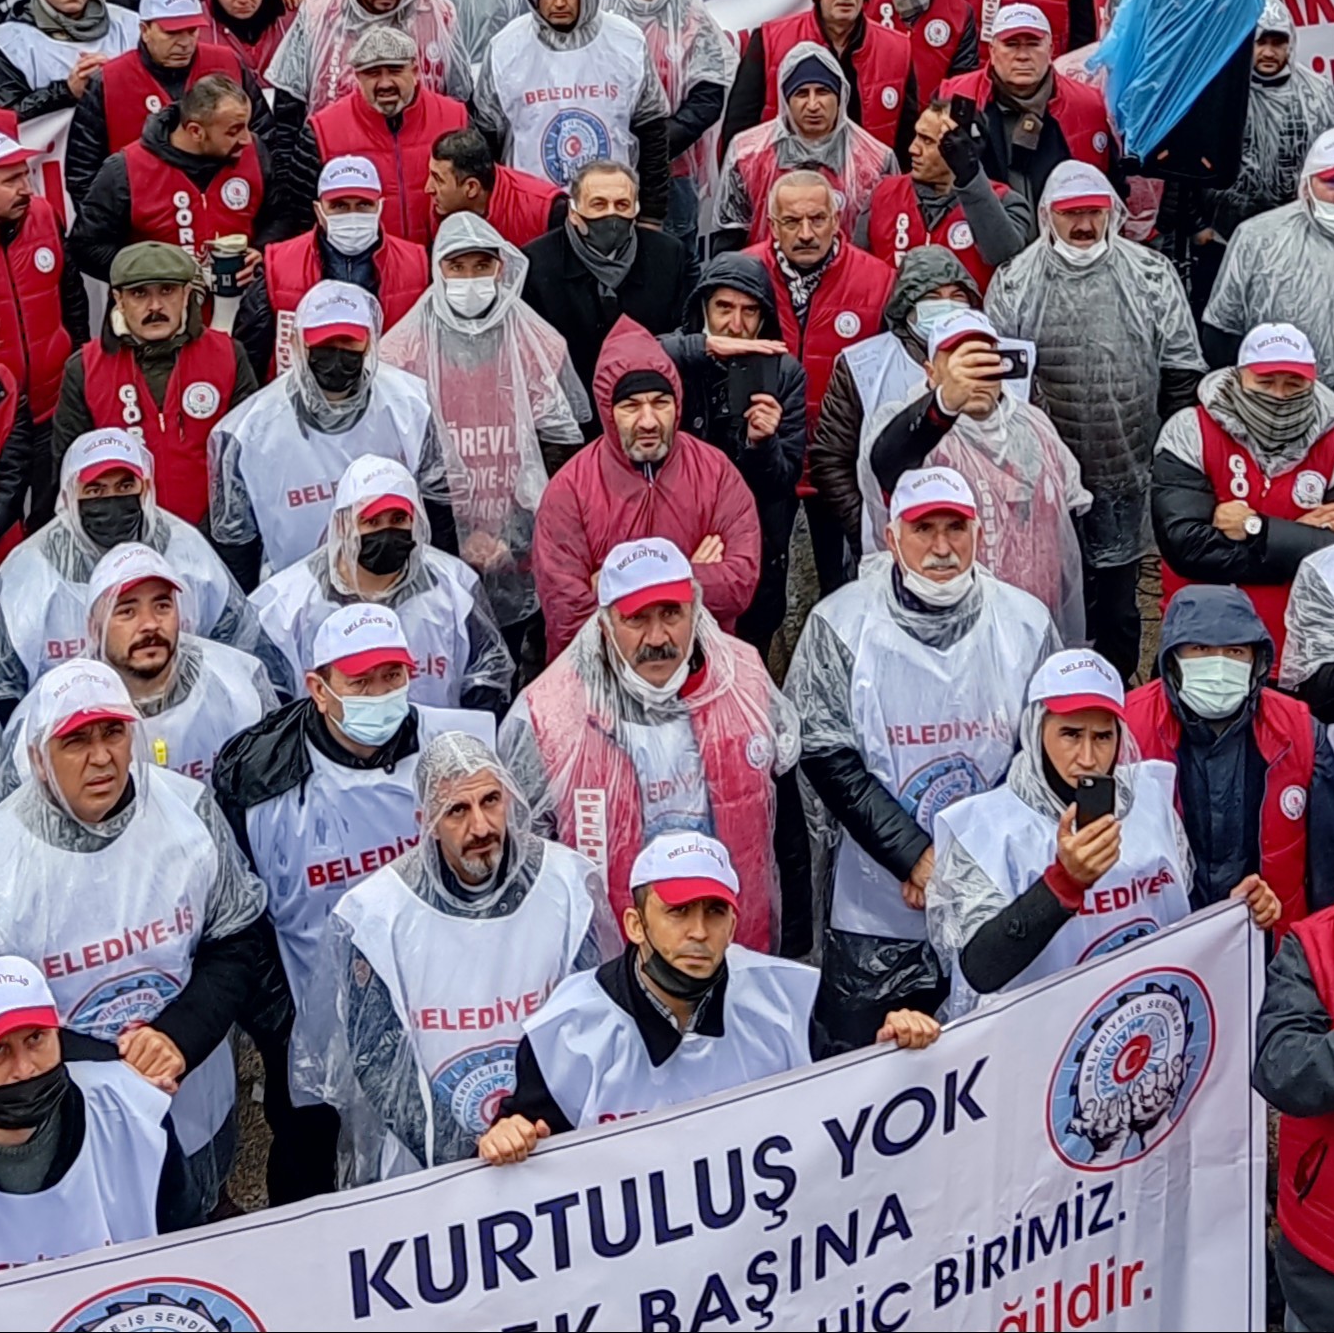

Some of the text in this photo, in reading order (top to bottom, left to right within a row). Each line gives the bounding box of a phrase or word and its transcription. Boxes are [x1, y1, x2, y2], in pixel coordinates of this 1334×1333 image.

[524, 84, 620, 105] BELEDİYE-İŞ
[349, 1054, 990, 1320] KURTULUŞ YOK
[935, 1180, 1127, 1310] BİRİMİZ.
[640, 1193, 914, 1333] BAŞINA
